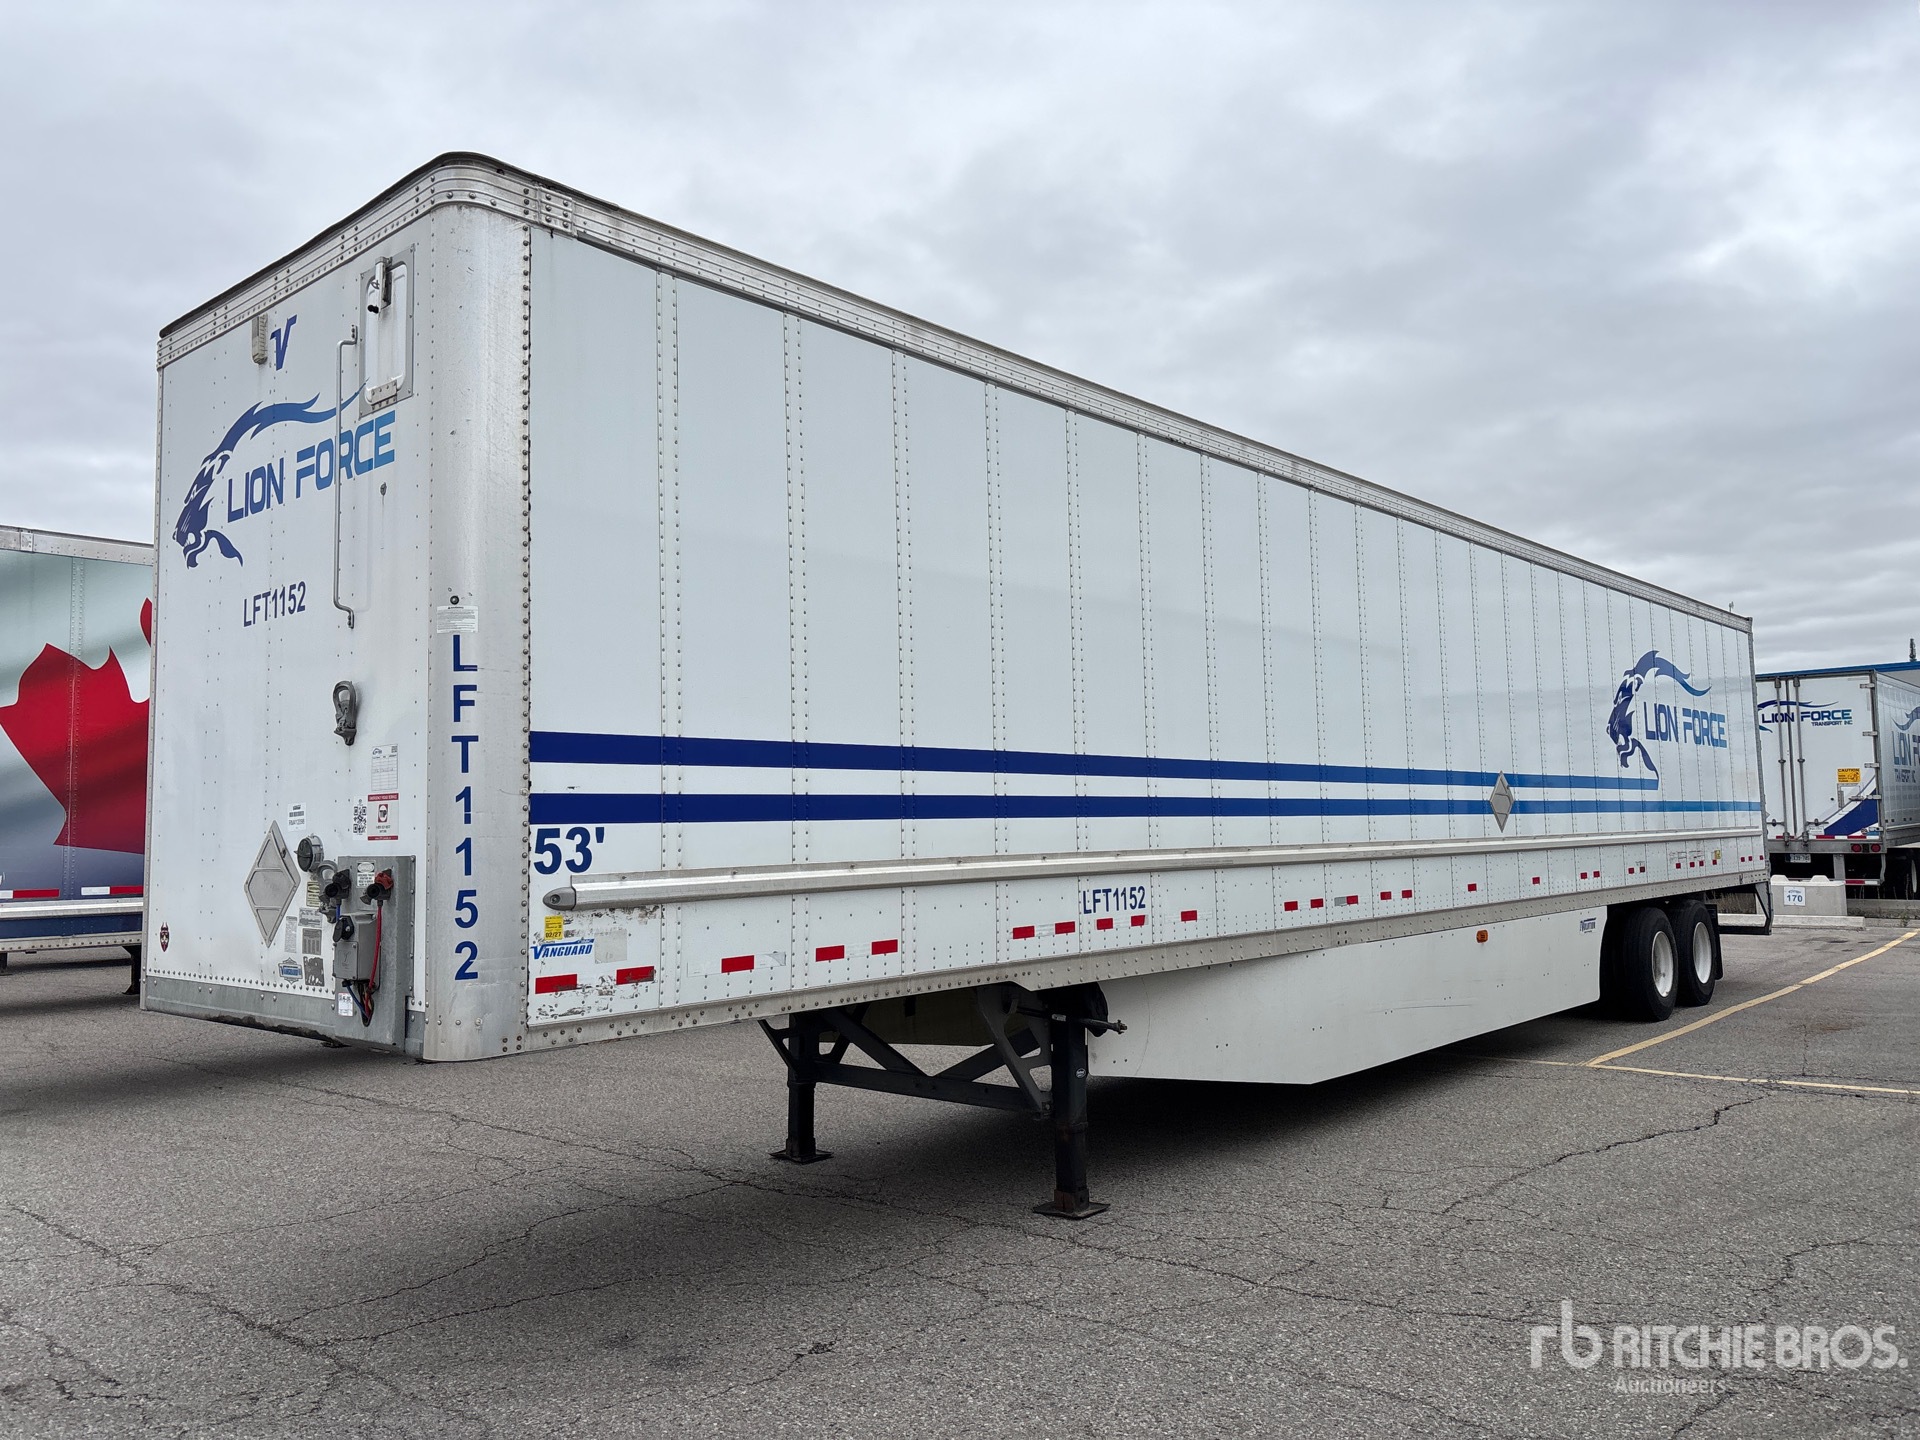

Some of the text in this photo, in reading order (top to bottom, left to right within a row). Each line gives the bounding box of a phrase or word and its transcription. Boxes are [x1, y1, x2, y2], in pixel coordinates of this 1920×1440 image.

[227, 410, 396, 523] LION FORCE
[243, 581, 306, 627] LFT1152
[1643, 701, 1727, 748] LION FORCE
[1761, 709, 1852, 723] LION FORCE
[533, 826, 604, 875] 53'
[1083, 886, 1146, 914] LFT1152
[530, 944, 594, 960] VANGUARD
